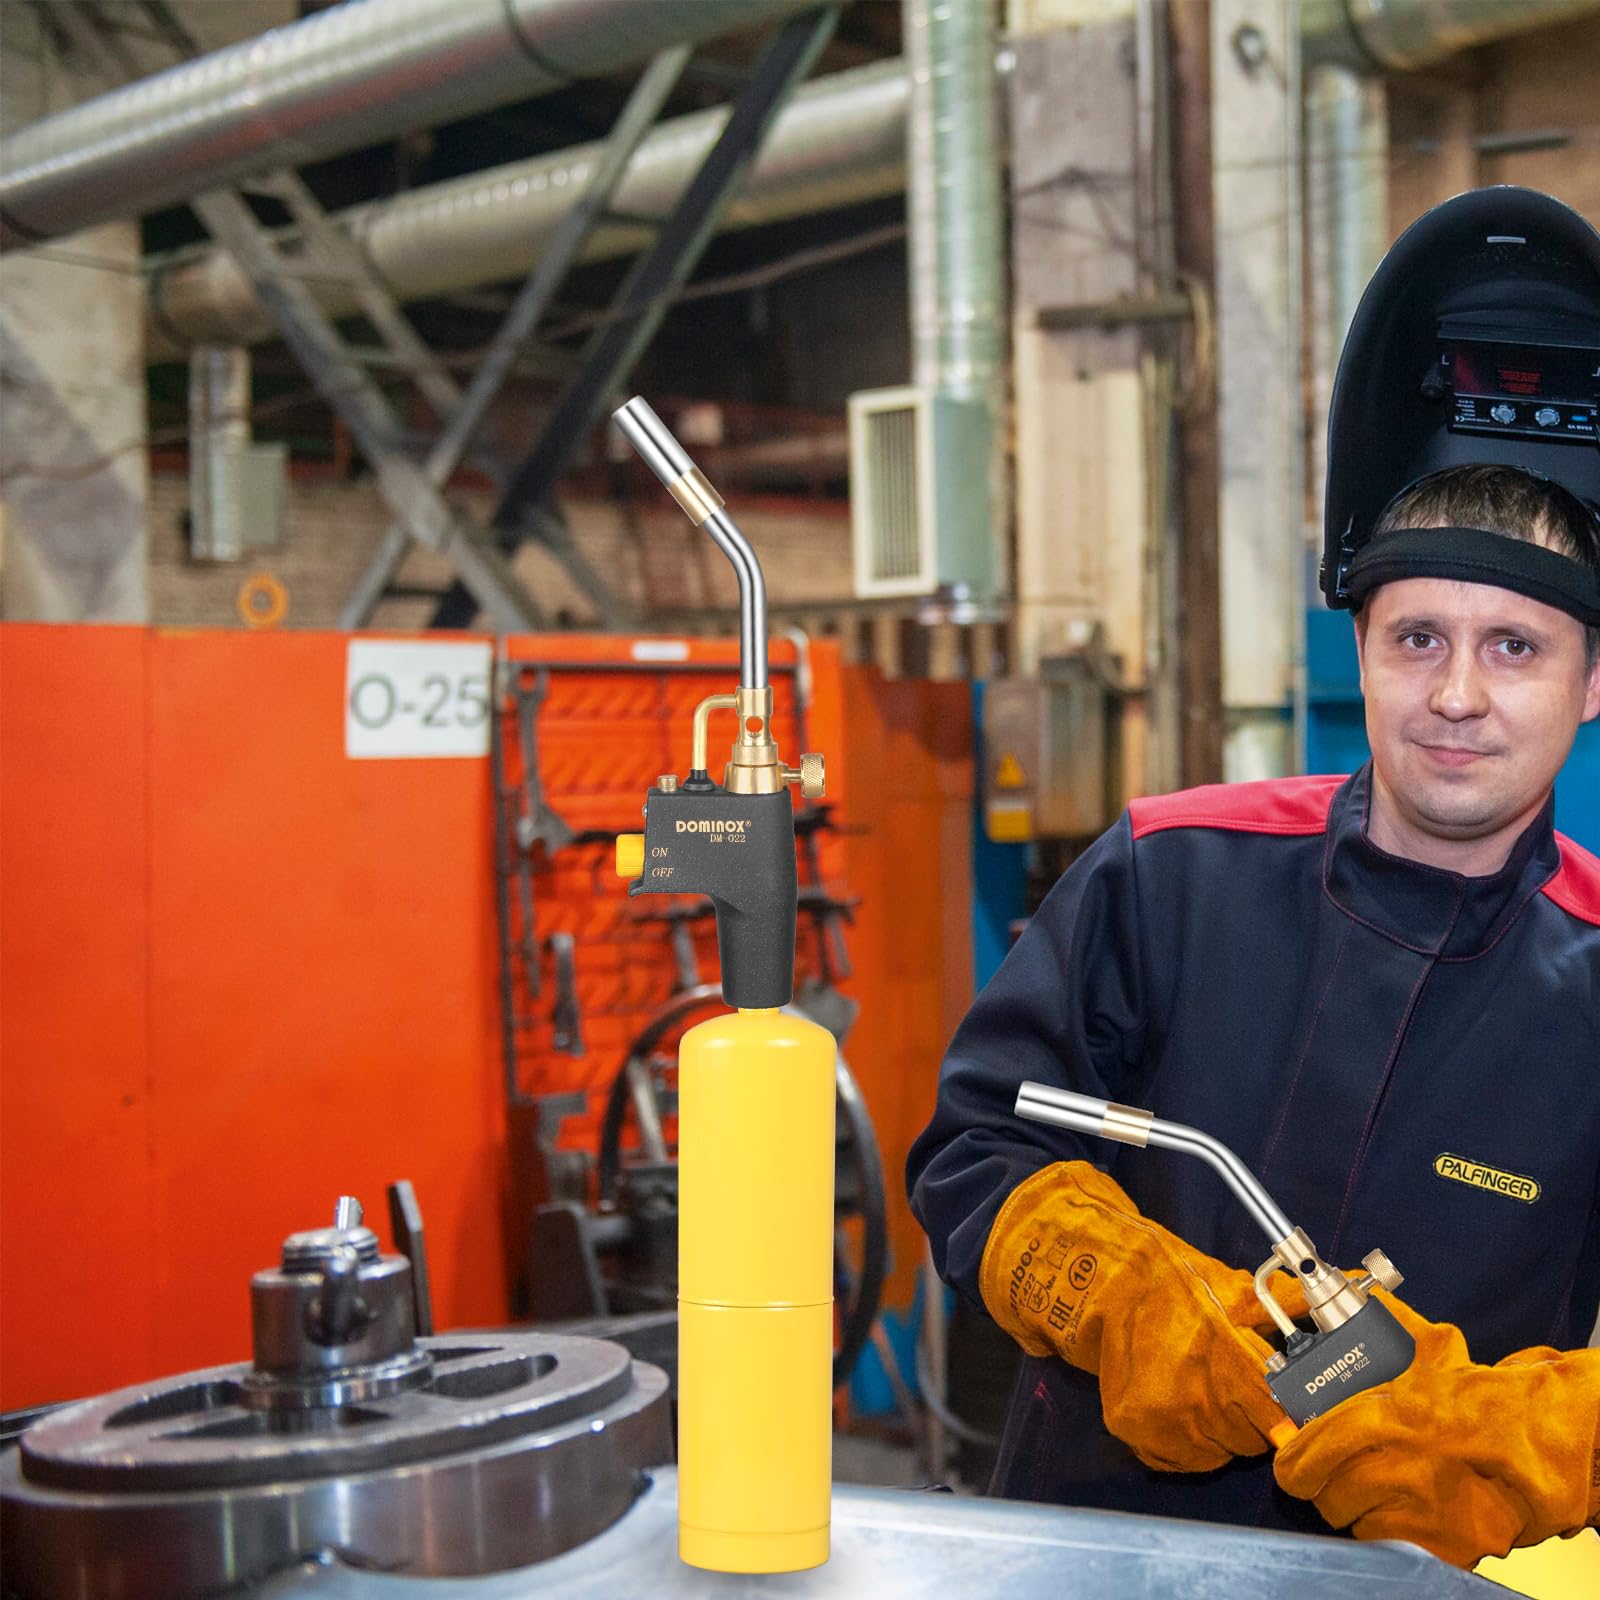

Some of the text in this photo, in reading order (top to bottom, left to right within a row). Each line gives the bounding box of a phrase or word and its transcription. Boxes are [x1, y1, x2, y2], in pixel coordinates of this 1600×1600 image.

[652, 847, 669, 858] ON
[652, 868, 674, 878] OFF
[1440, 1158, 1532, 1198] PALFINGER
[1073, 1258, 1093, 1284] 10
[1339, 1357, 1371, 1383] DM-022
